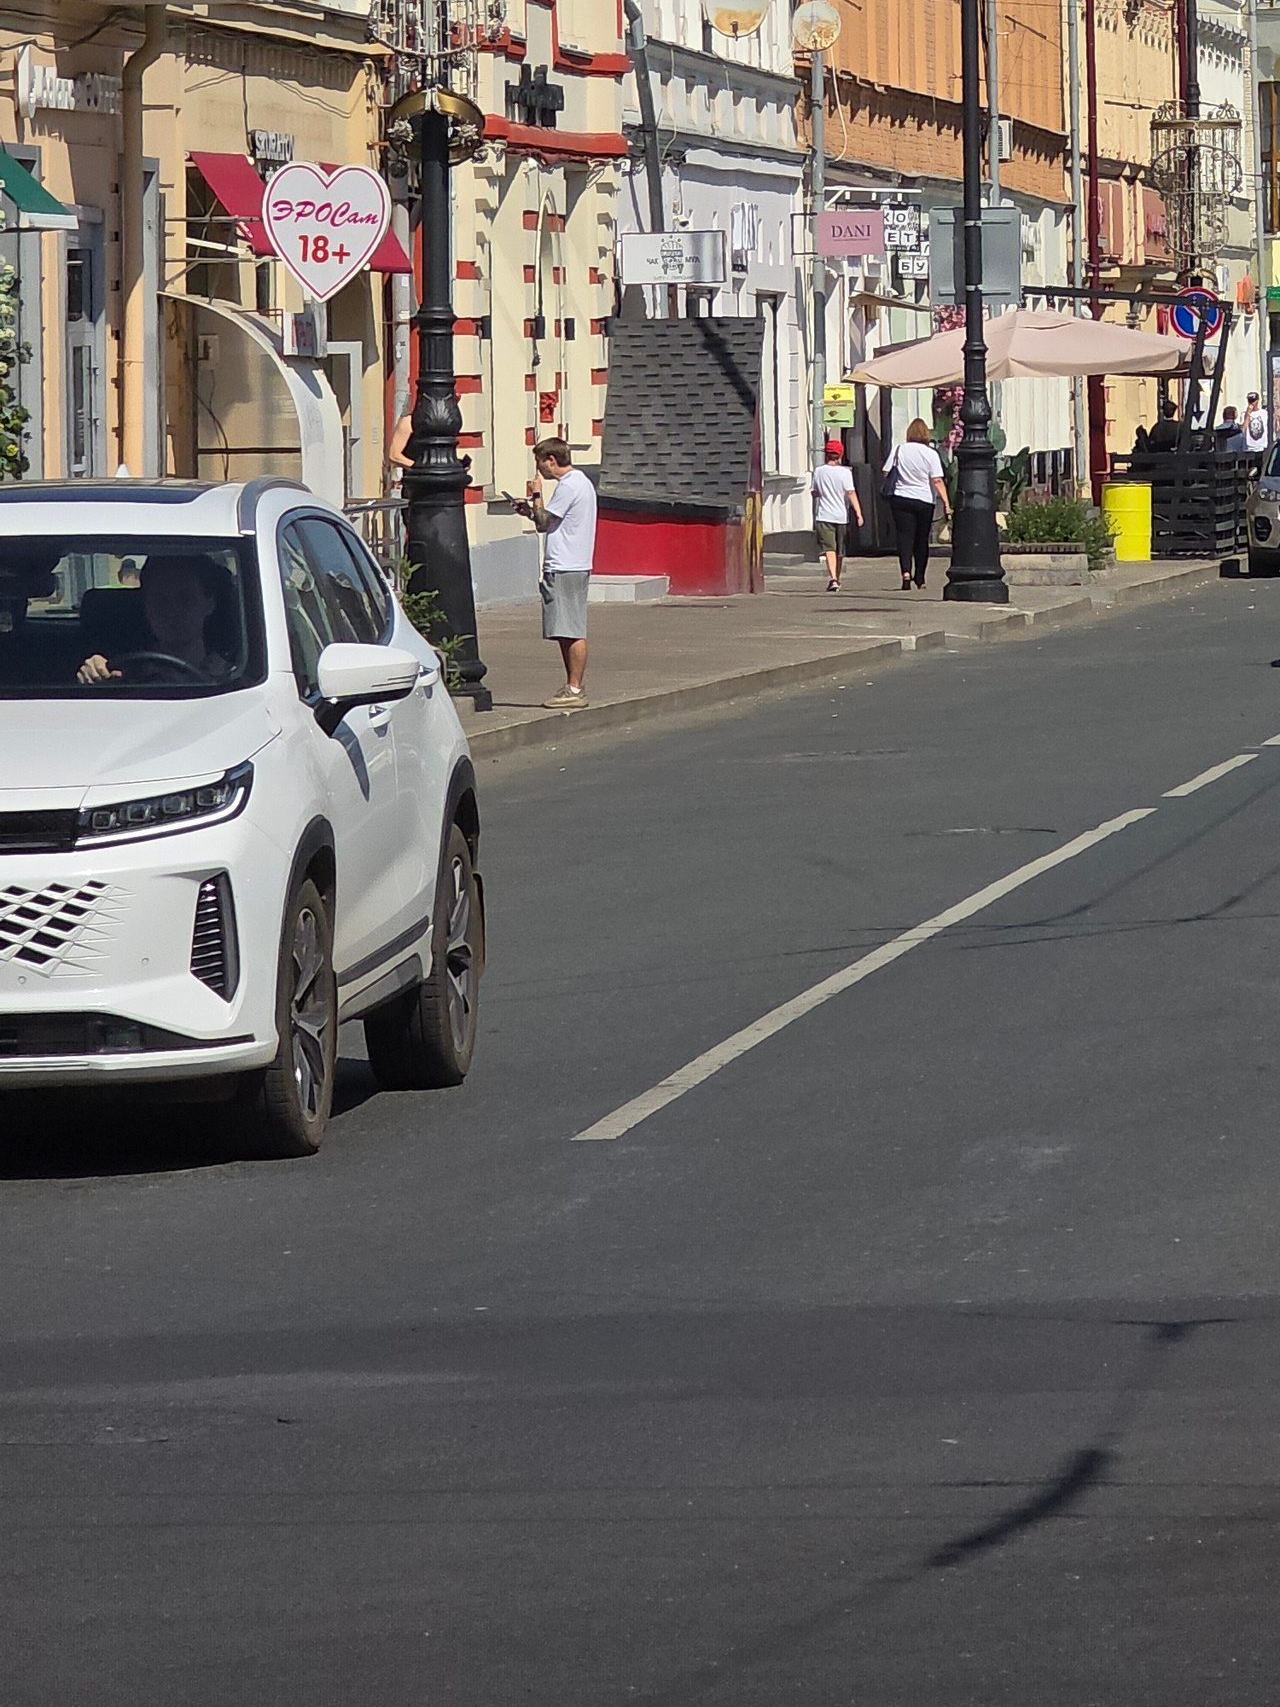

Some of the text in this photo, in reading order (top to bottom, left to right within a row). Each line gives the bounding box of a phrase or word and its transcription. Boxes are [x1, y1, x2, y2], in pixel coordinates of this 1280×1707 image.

[272, 200, 379, 227] ЭРОСам
[832, 224, 871, 238] DANI
[298, 235, 351, 264] 18+
